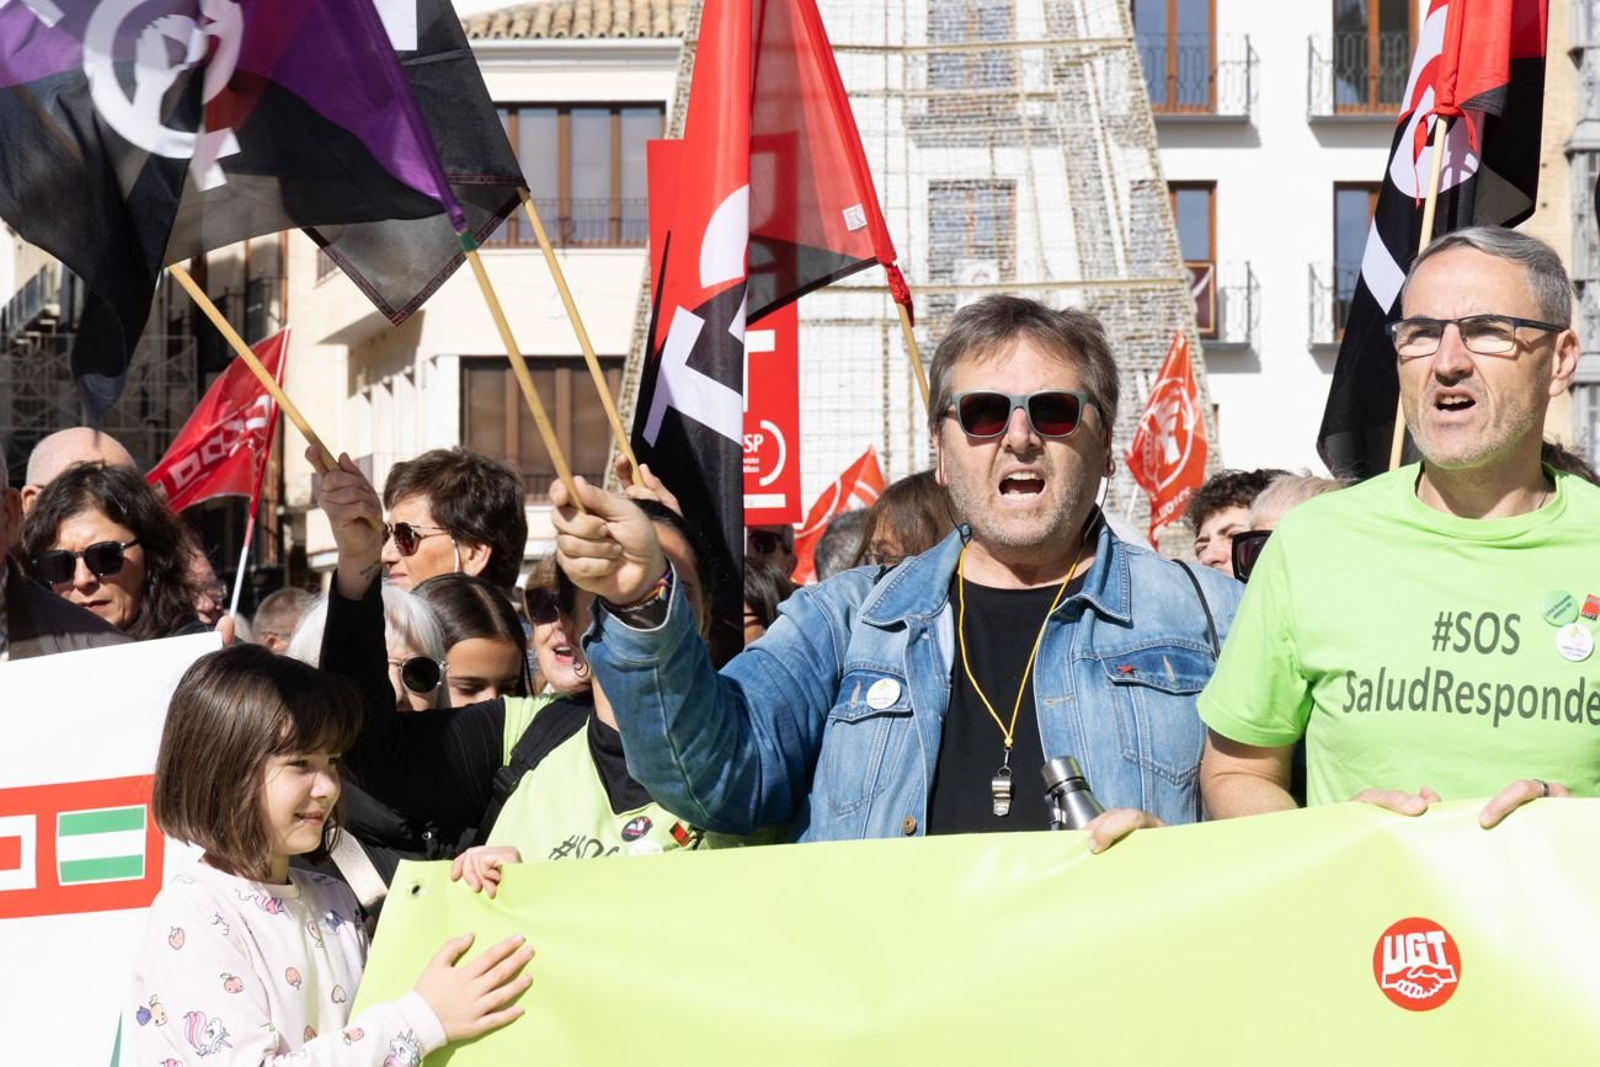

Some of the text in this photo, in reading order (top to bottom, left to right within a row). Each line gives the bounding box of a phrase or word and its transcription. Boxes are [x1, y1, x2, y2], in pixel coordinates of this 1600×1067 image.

[743, 433, 764, 453] SP
[1431, 611, 1521, 655] #SOS
[1342, 665, 1600, 728] SaludResponde
[1382, 930, 1447, 972] UGT
